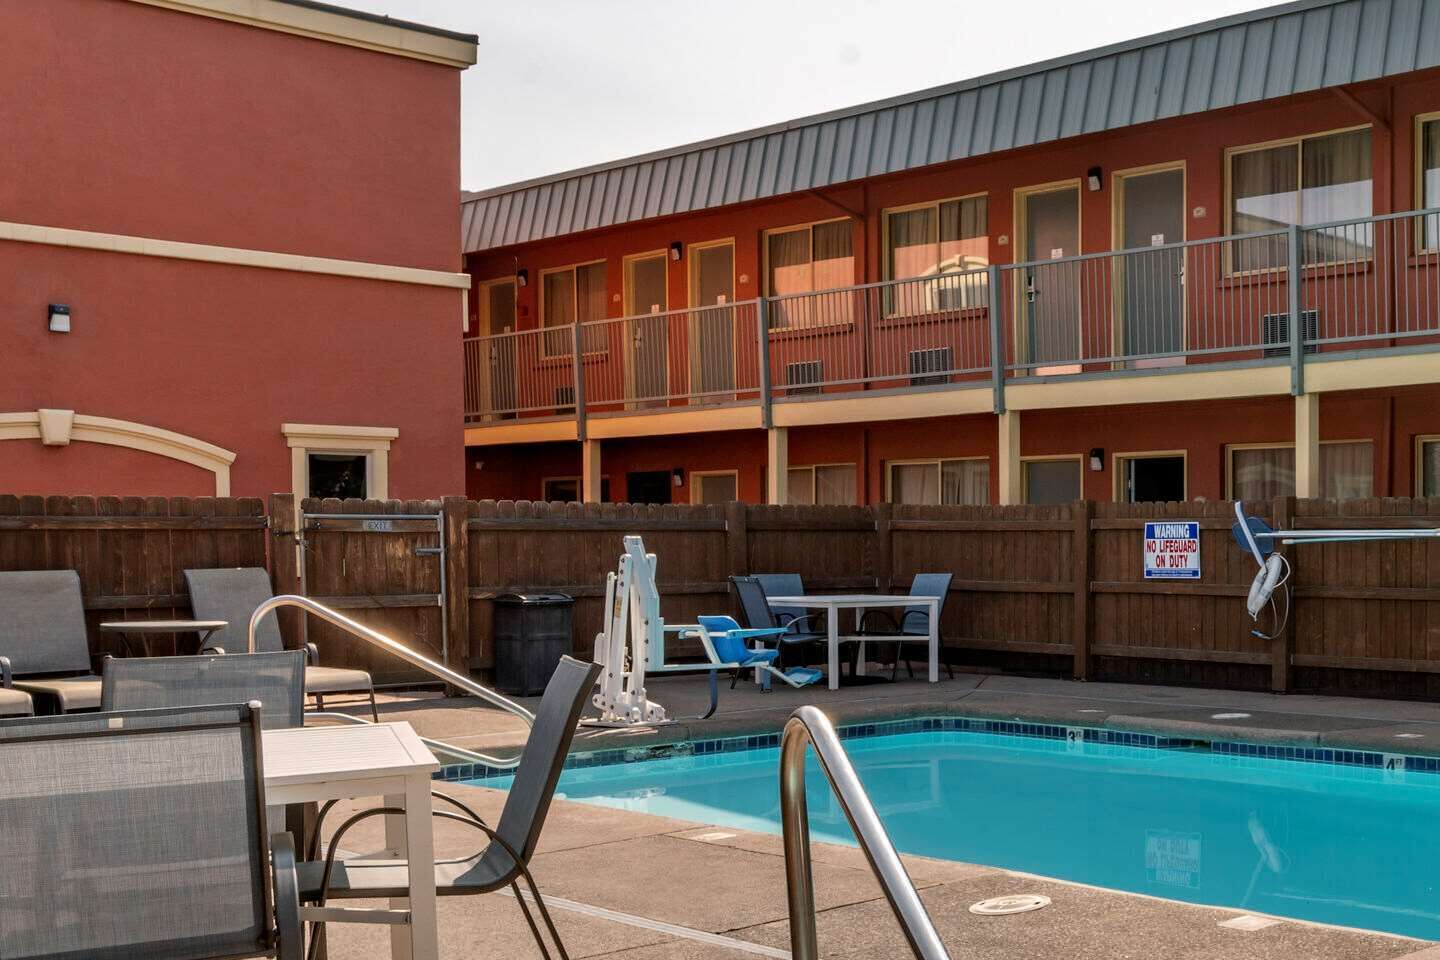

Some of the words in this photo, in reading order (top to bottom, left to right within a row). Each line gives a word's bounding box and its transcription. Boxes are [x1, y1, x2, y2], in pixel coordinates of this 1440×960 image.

[1154, 524, 1190, 539] WARNING
[1146, 540, 1157, 553] NO
[1160, 540, 1197, 553] LIFEGUARD
[1155, 554, 1166, 568] ON
[1169, 554, 1188, 568] DUTY
